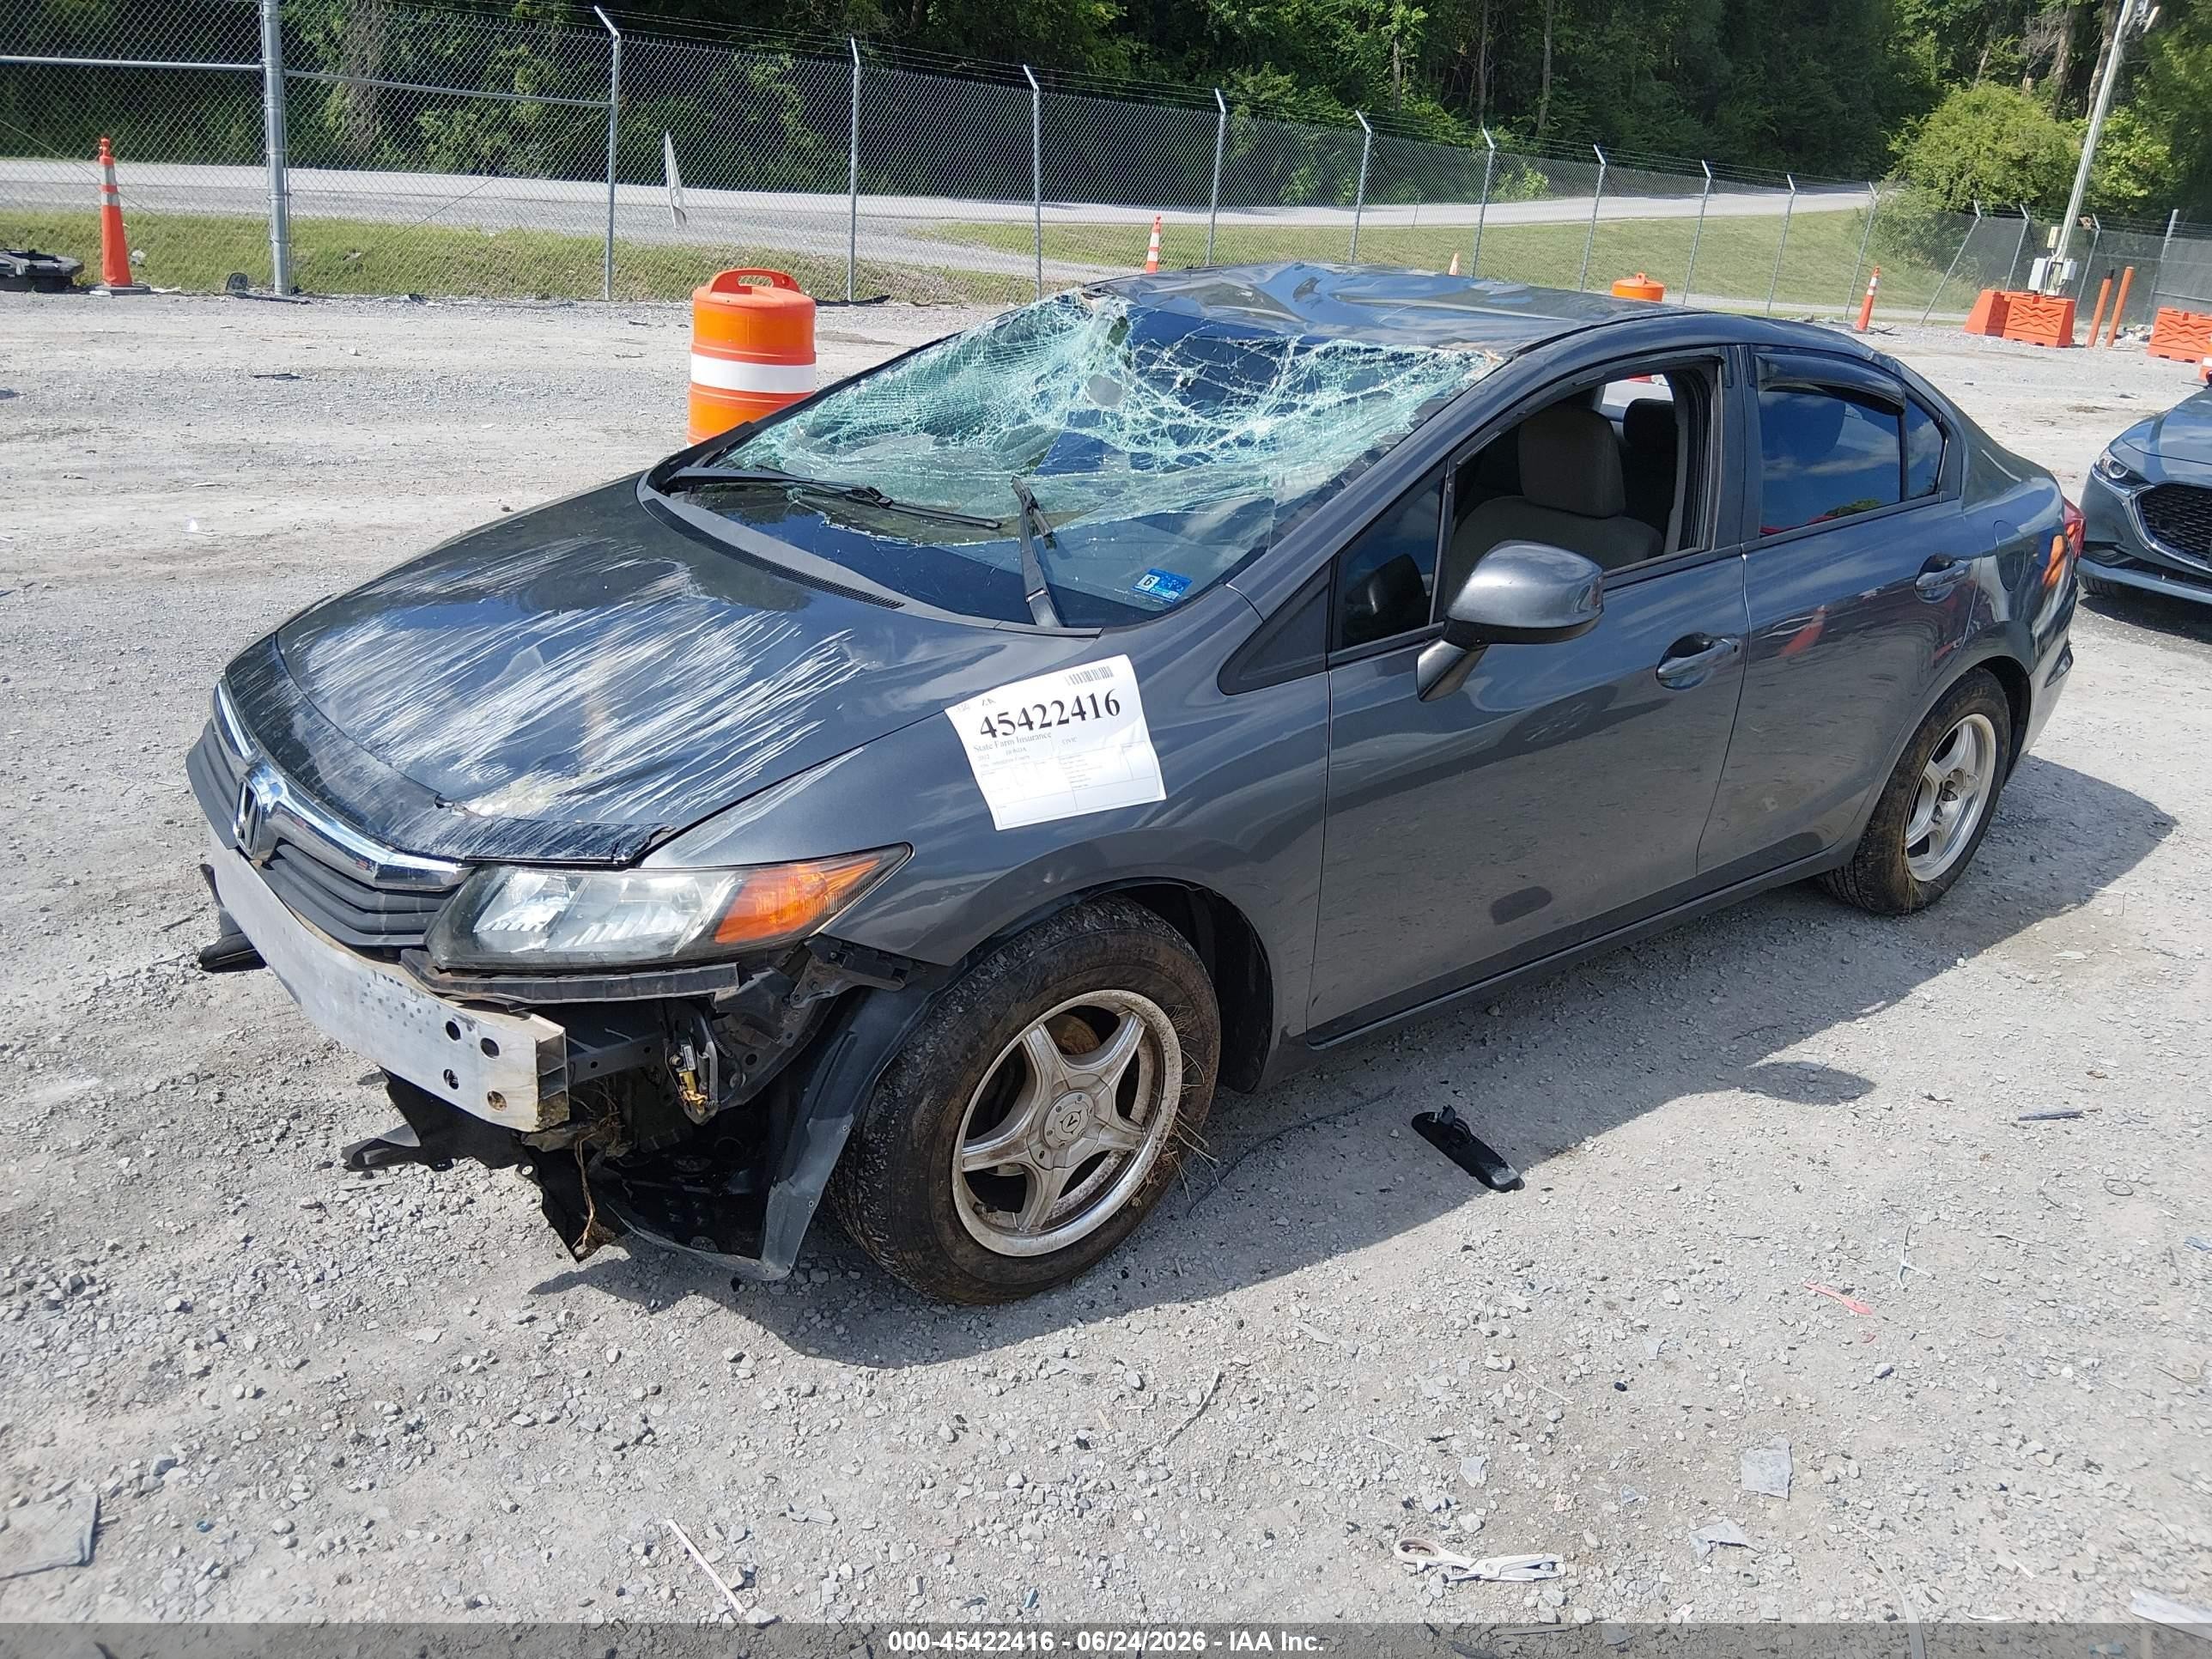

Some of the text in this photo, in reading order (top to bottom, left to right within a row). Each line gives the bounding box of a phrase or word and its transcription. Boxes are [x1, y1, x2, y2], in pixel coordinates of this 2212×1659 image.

[980, 689, 1121, 738] 45422416
[973, 731, 1052, 752] State Farm Insurance
